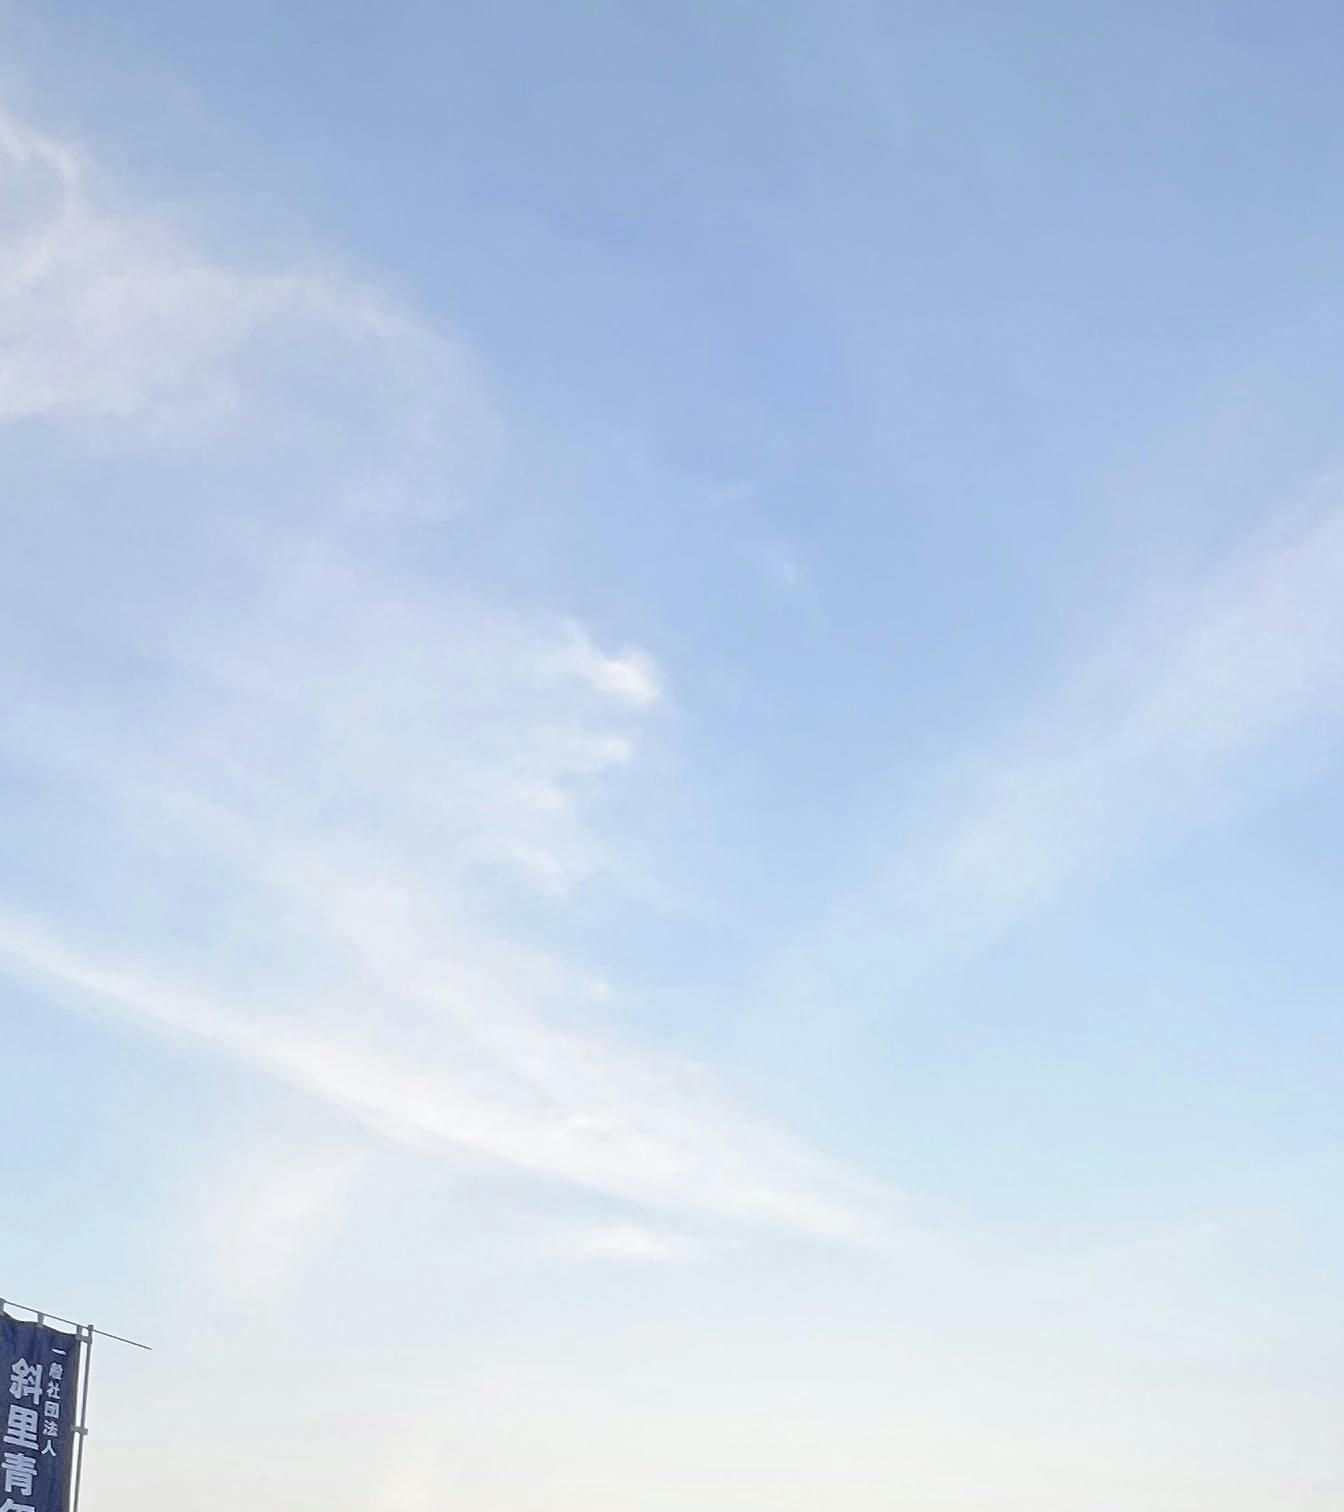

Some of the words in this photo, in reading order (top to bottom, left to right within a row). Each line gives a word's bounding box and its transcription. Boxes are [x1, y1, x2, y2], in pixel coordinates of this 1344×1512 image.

[41, 1348, 67, 1457] 一般社団法人
